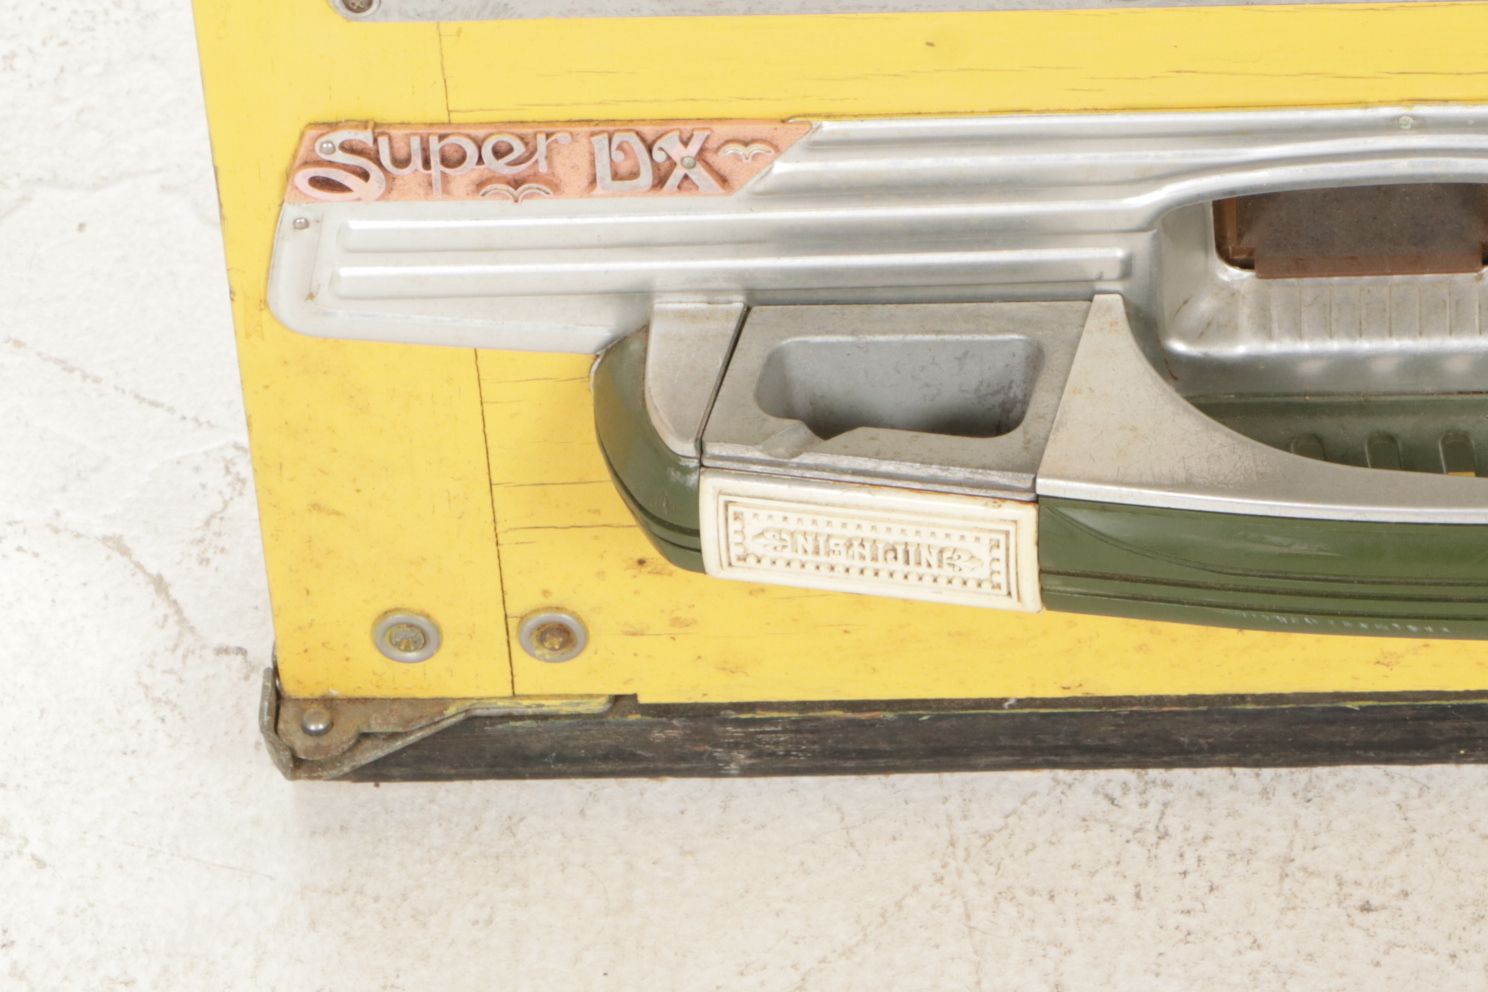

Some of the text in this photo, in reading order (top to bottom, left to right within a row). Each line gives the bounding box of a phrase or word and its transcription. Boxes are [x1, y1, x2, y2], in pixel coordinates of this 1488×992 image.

[294, 128, 730, 202] Super DX
[795, 532, 942, 569] NISHIJIN
